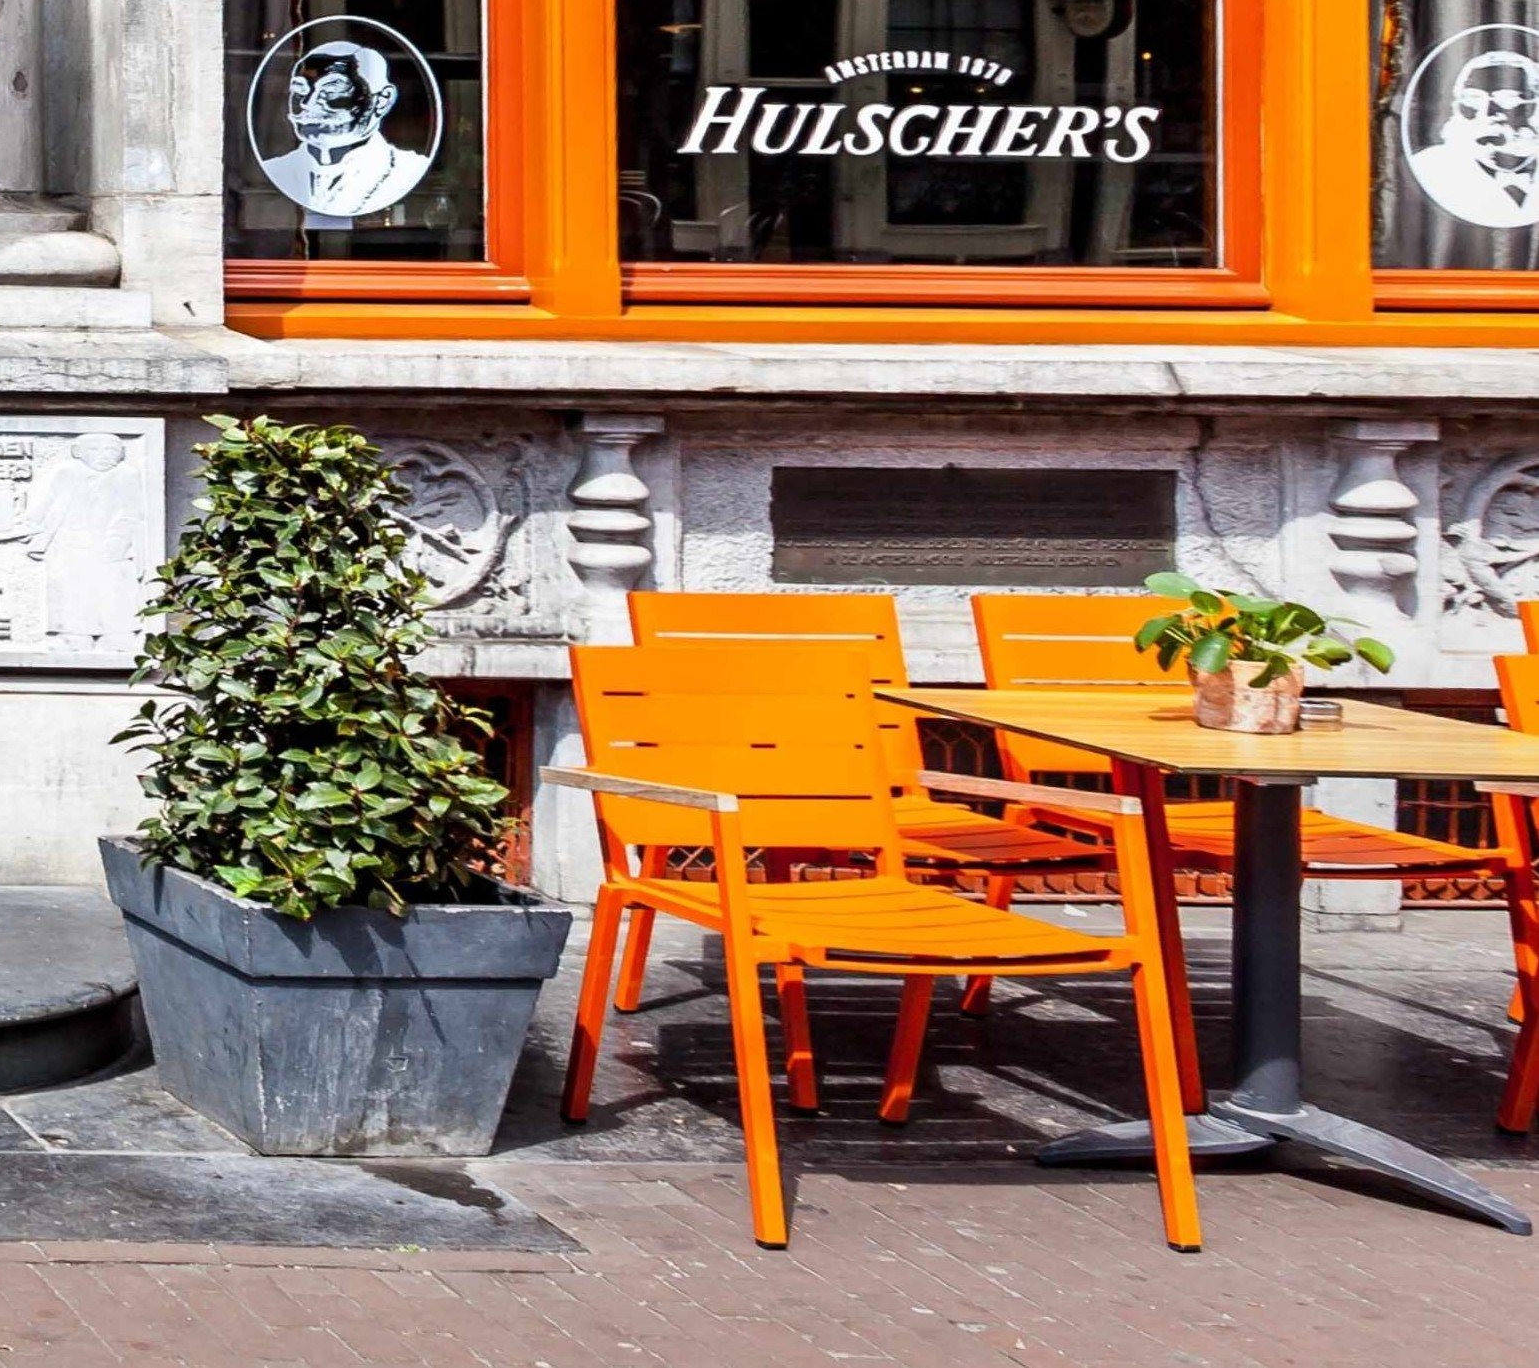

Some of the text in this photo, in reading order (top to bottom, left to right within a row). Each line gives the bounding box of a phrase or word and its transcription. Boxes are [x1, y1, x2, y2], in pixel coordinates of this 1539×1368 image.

[824, 50, 1015, 87] AMSTERDAM 1870
[676, 86, 1159, 163] HULSCHER'S
